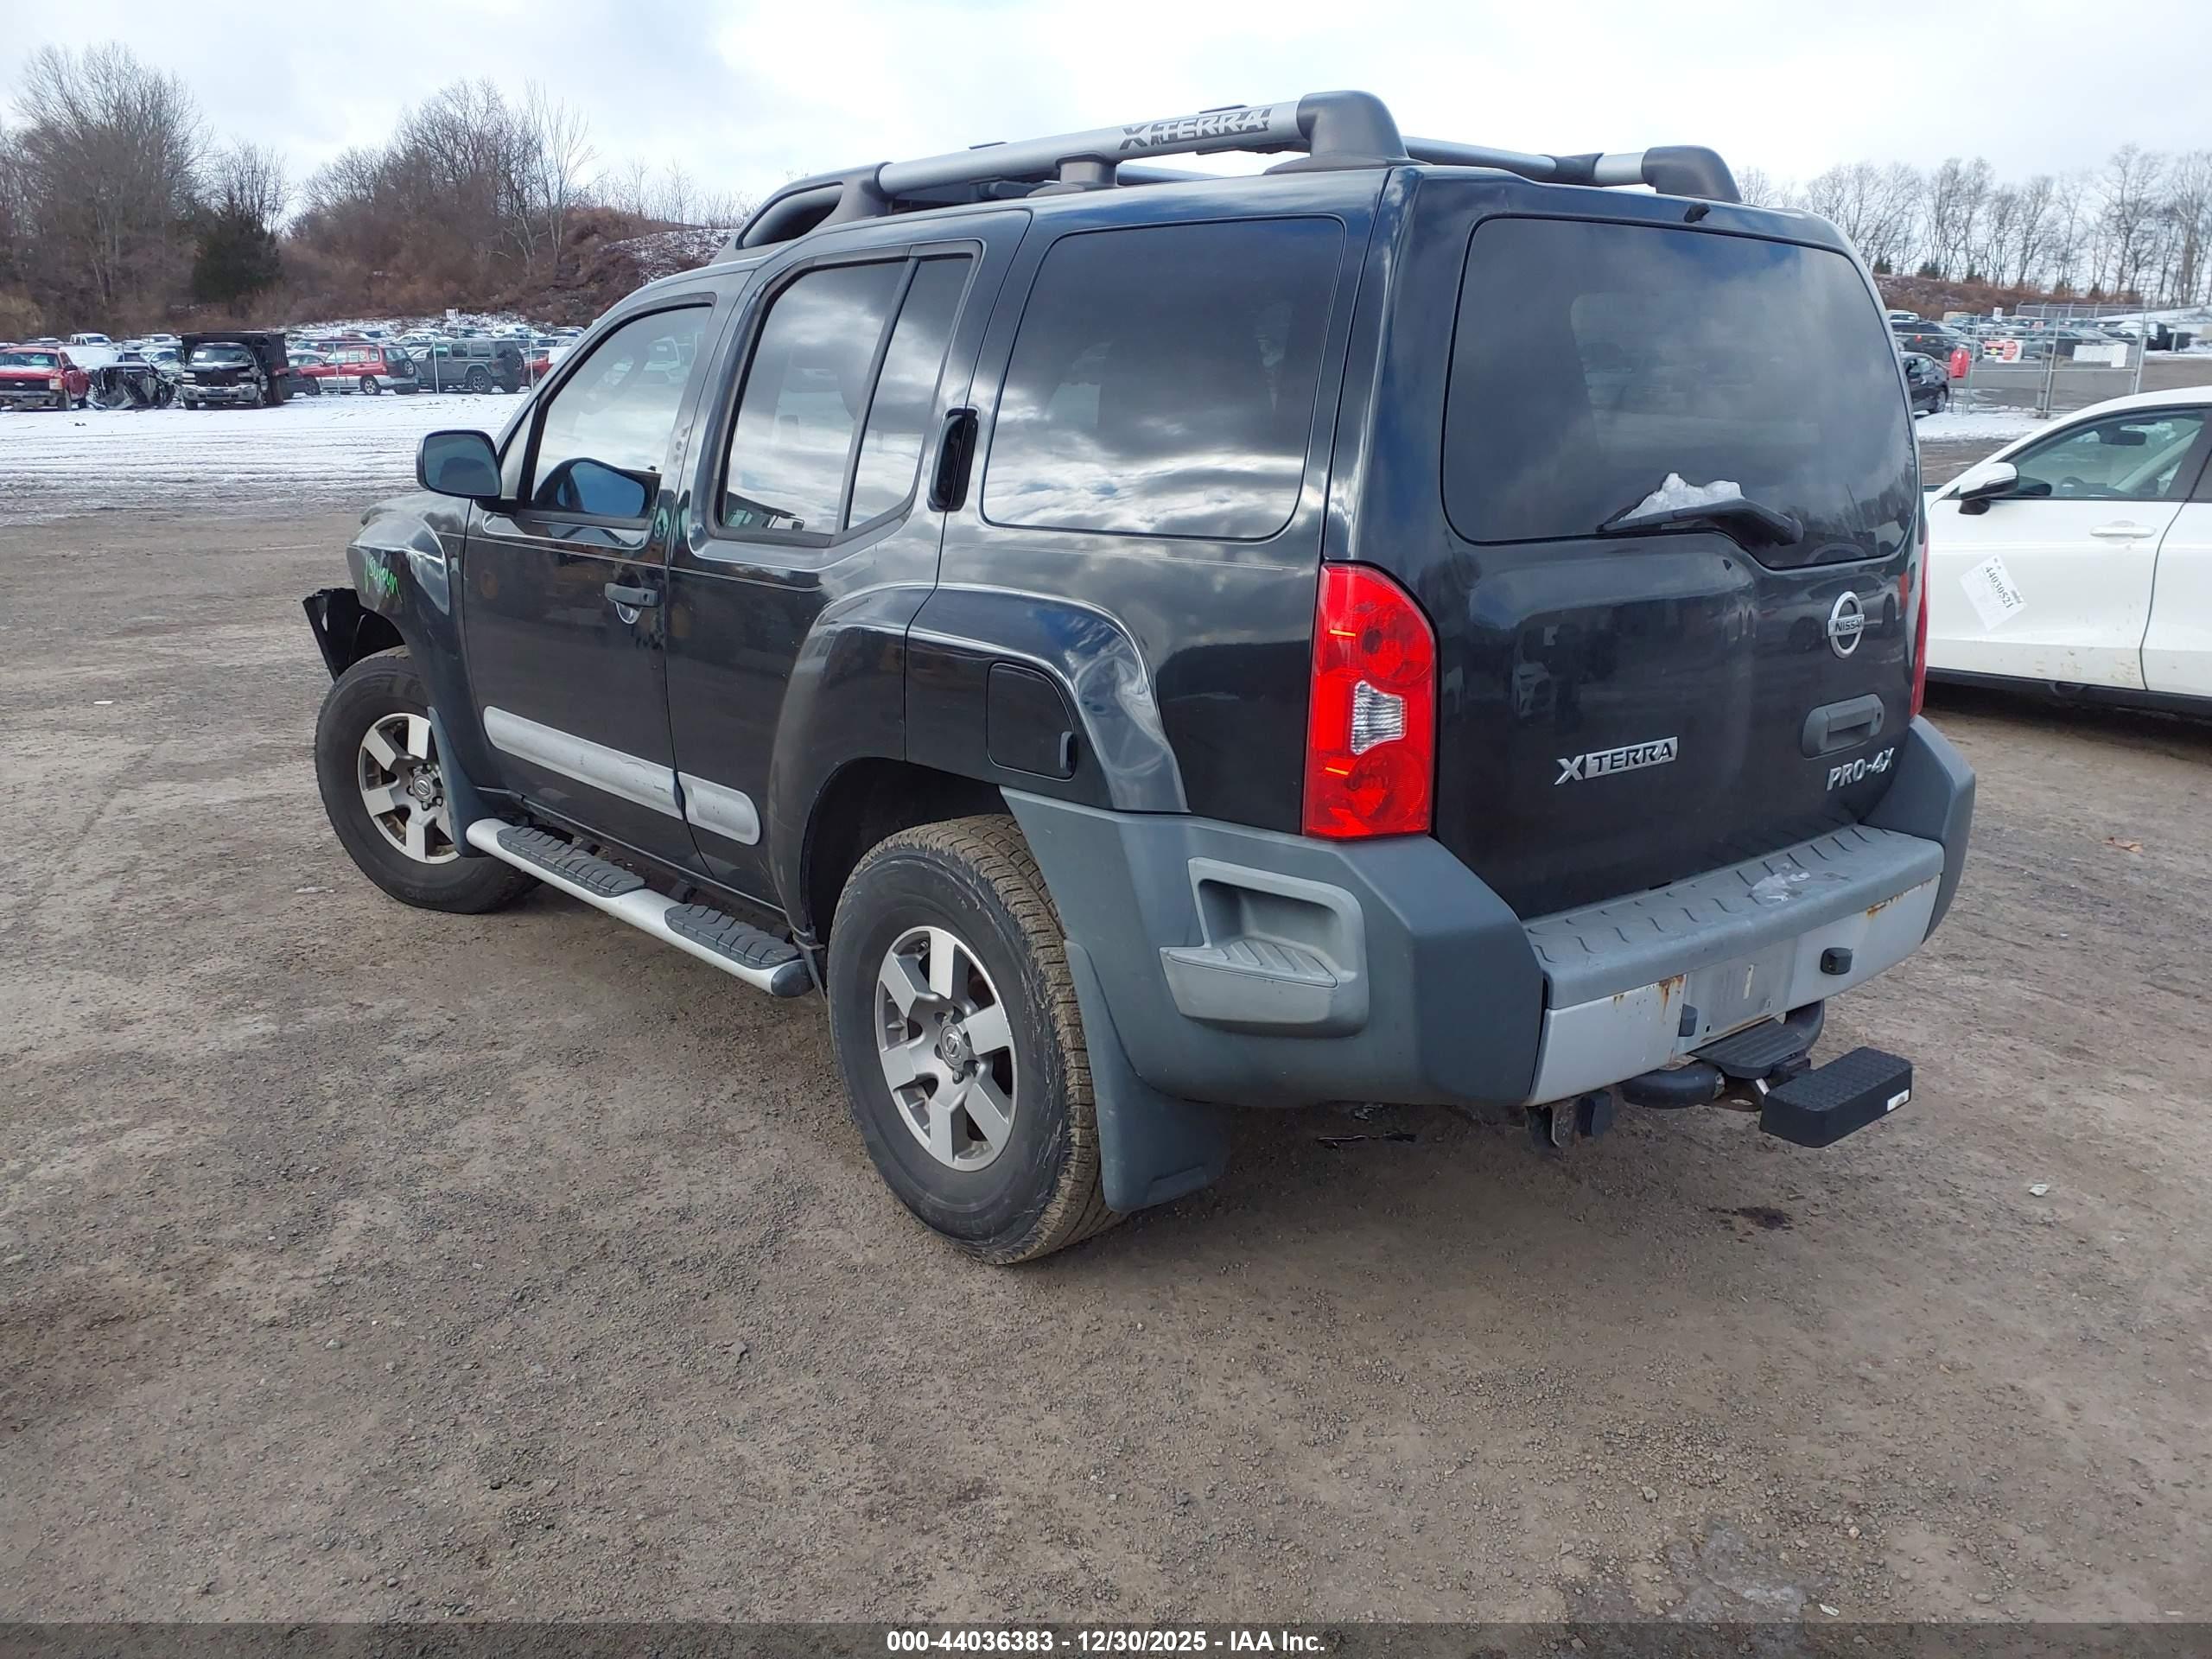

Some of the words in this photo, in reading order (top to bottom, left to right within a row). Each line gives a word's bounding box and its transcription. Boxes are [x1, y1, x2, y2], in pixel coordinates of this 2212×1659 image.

[1119, 107, 1273, 150] XTERRA
[1985, 566, 2015, 609] 44030521
[1554, 736, 1678, 785] XTERRA
